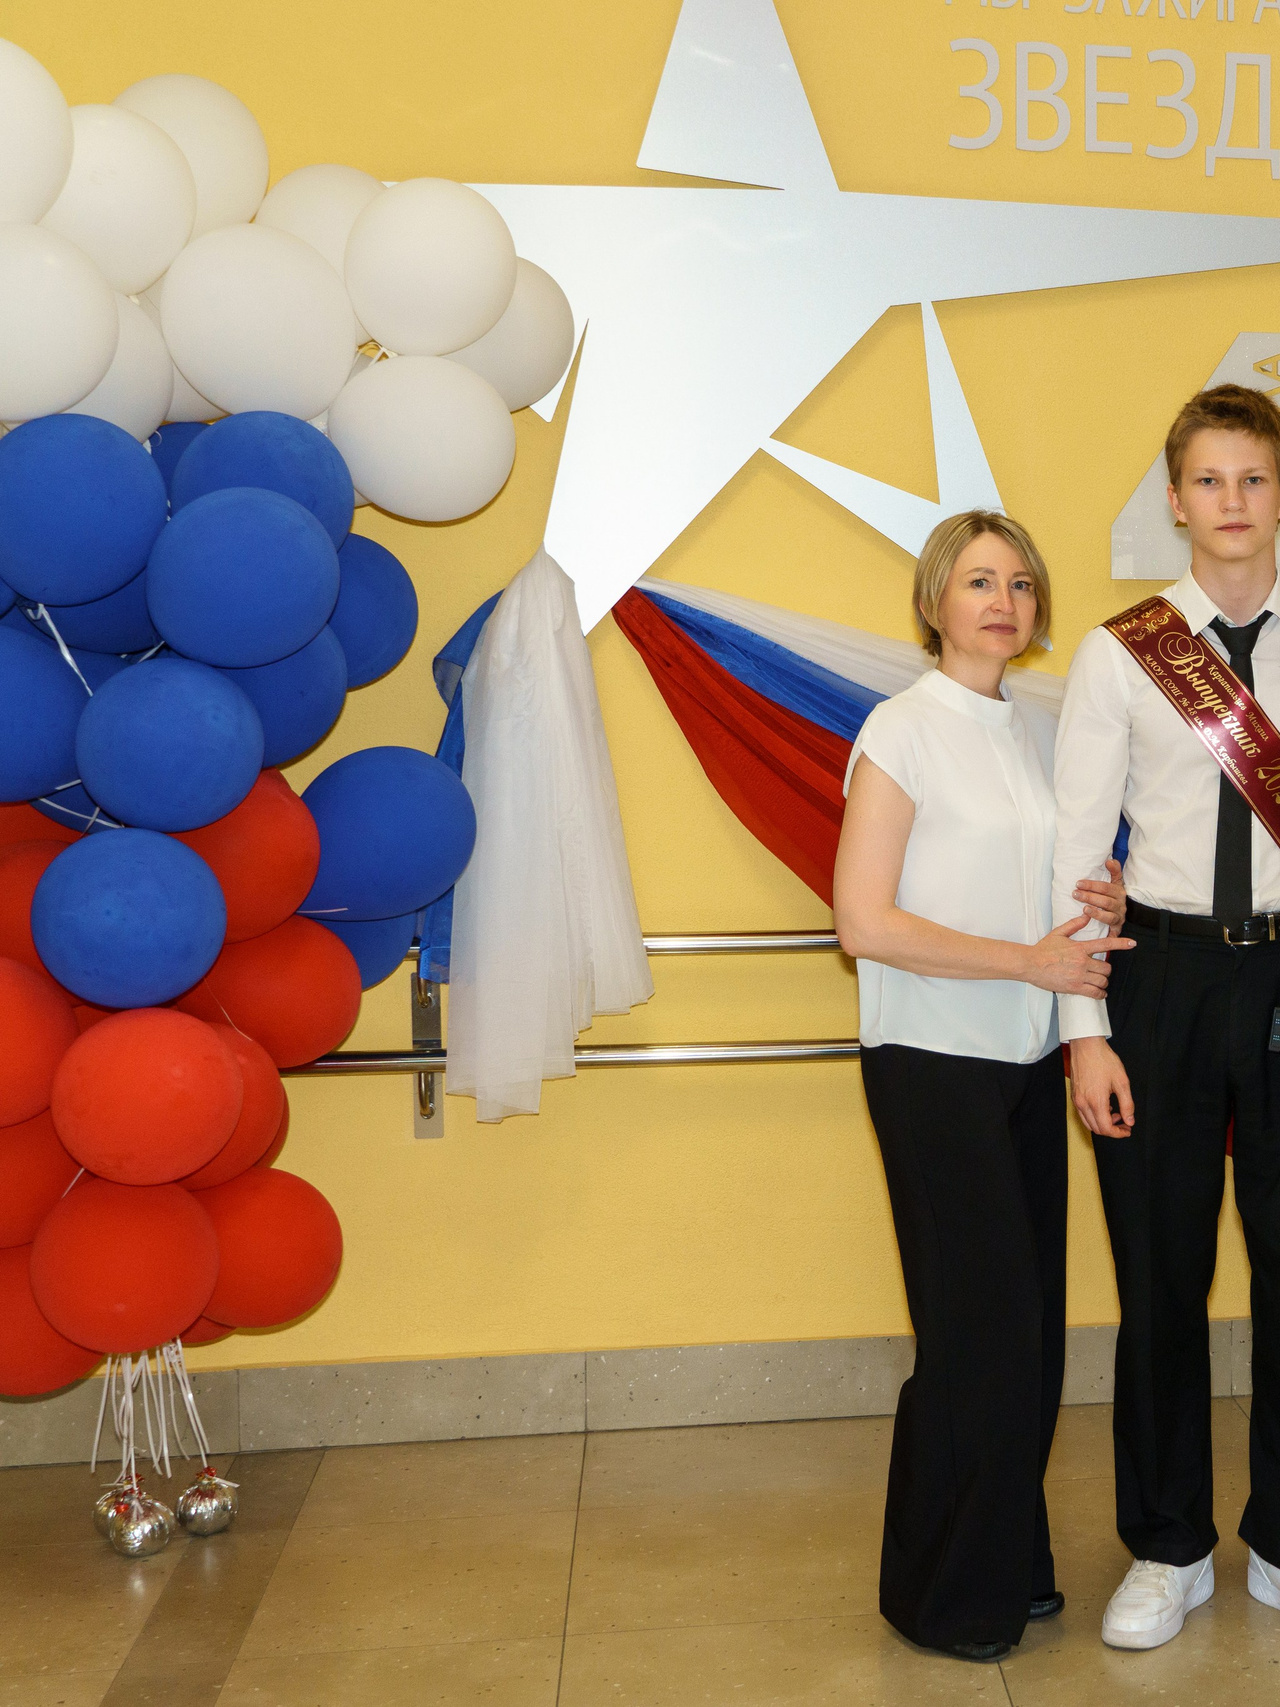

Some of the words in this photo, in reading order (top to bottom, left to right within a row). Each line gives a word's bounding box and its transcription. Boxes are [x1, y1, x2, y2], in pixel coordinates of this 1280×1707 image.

[1143, 654, 1168, 677] МАОУ
[1163, 678, 1184, 697] СОШ
[1187, 707, 1198, 716] 48
[1217, 745, 1249, 785] Карбышева
[1158, 631, 1261, 758] Выпускник
[1245, 711, 1269, 742] Михаил
